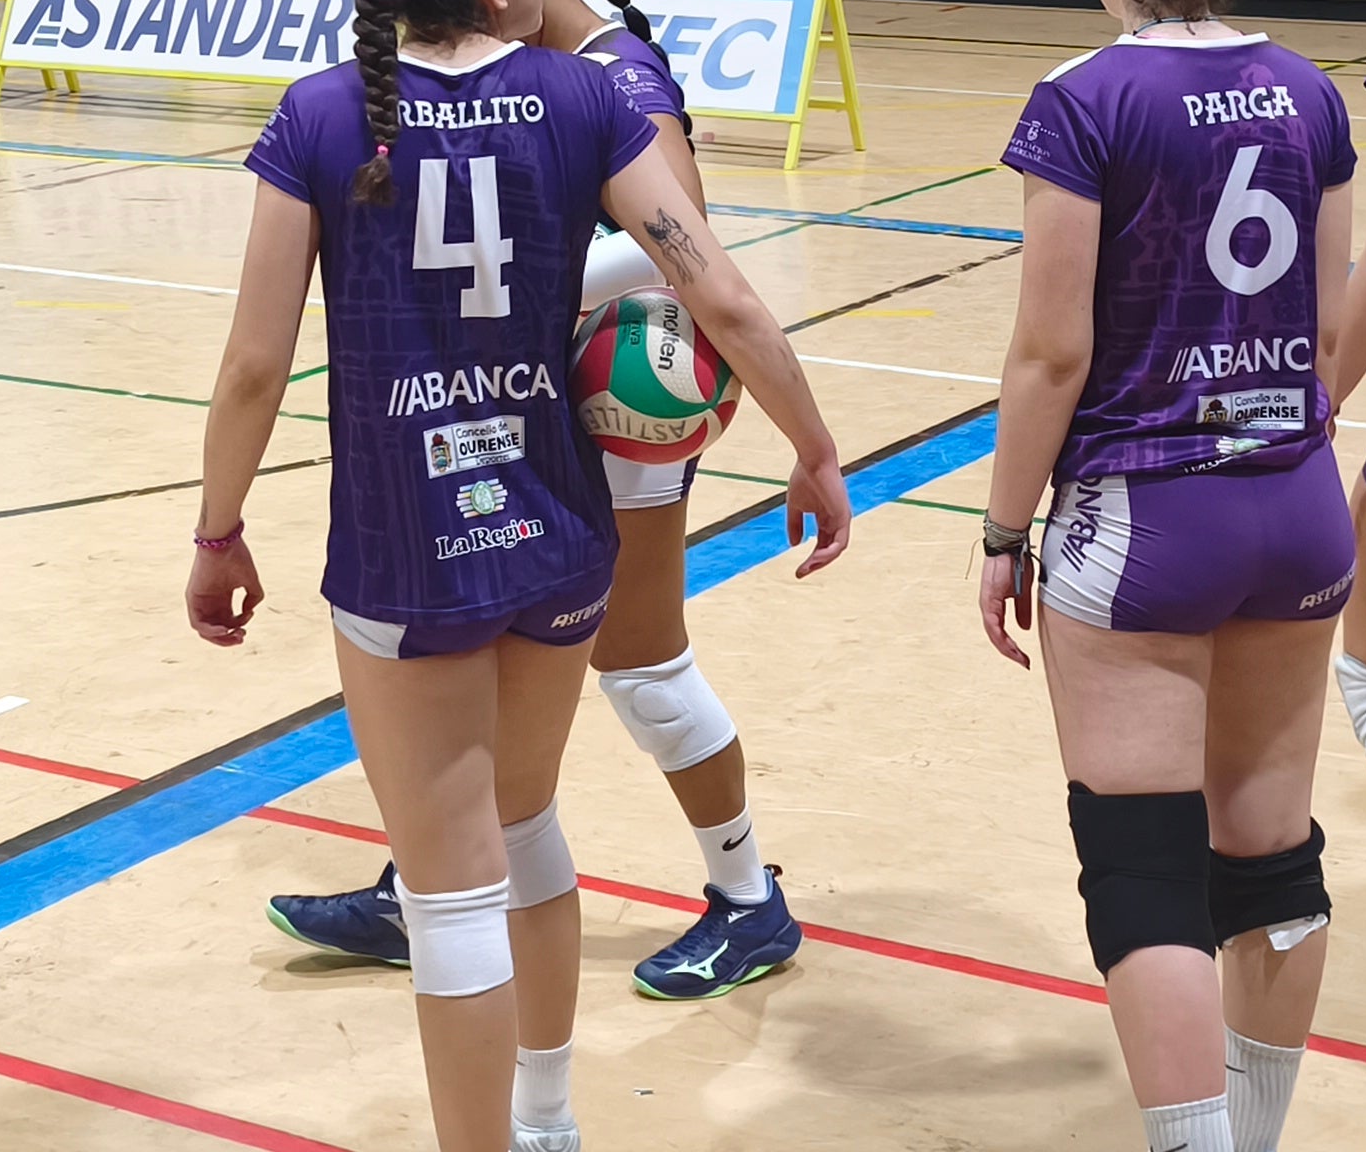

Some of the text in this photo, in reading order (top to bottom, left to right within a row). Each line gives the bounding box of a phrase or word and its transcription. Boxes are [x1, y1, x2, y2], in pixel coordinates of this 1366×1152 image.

[1181, 85, 1298, 128] PARGA
[1204, 144, 1299, 297] 6
[412, 155, 514, 319] 4
[657, 303, 681, 371] molten
[1234, 393, 1287, 407] Concello de
[1234, 405, 1300, 422] OURENSE
[455, 420, 510, 439] Concello de
[458, 432, 520, 456] OURENSE
[436, 536, 470, 560] La
